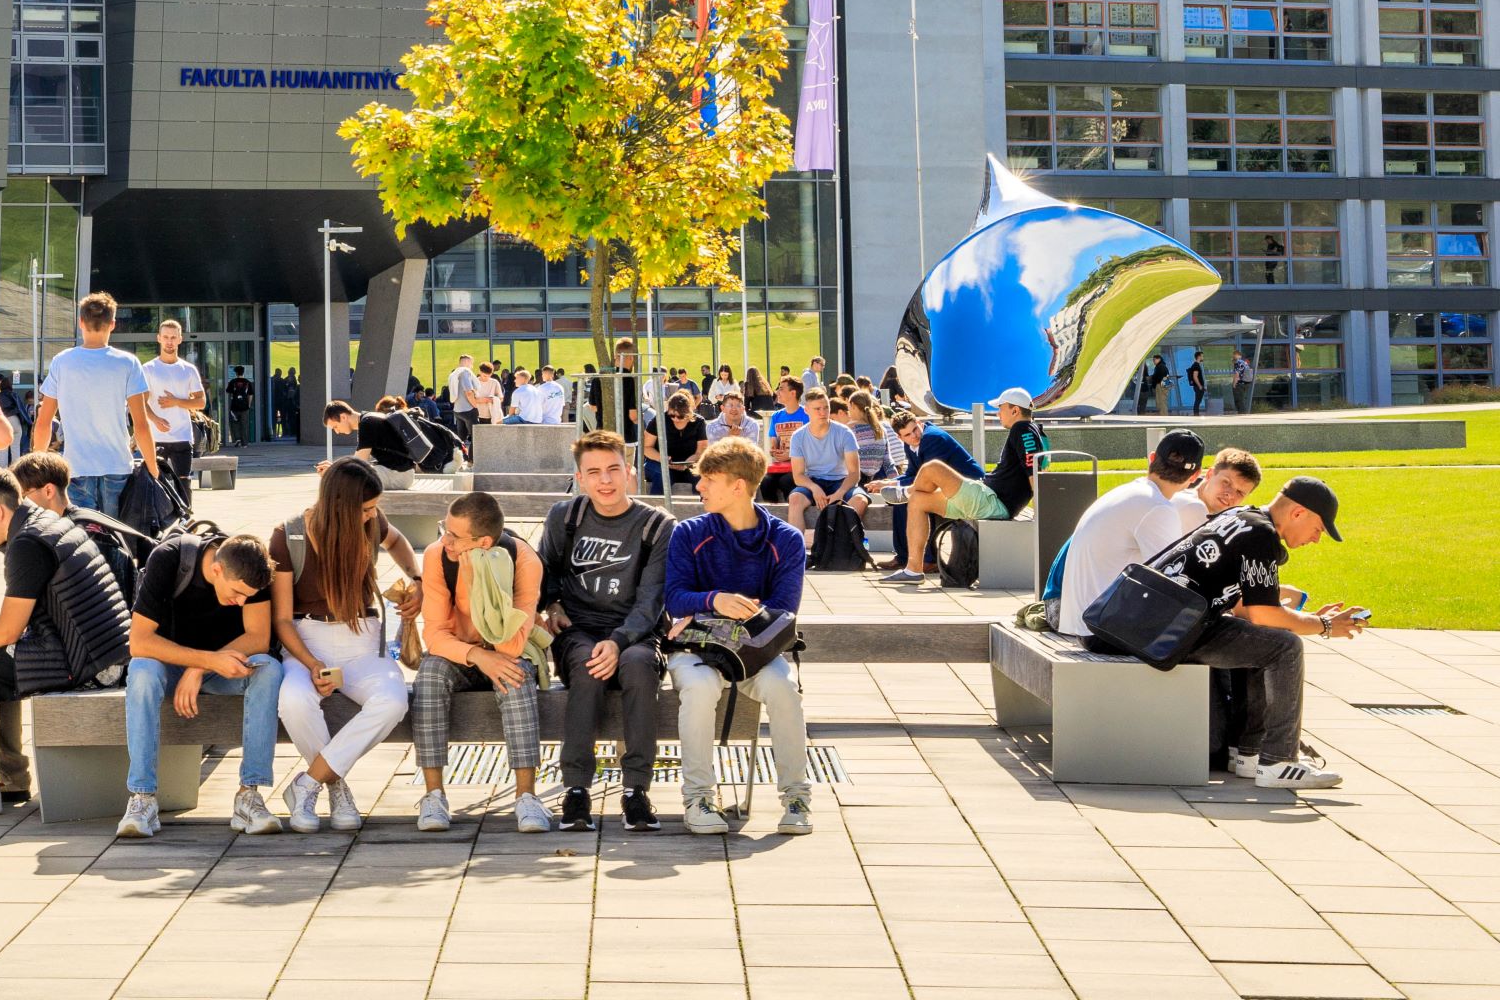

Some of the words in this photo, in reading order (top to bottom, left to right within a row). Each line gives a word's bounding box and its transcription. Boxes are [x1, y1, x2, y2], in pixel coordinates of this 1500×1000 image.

[180, 68, 266, 88] FAKULTA
[271, 68, 409, 91] HUMANITNÝC
[574, 536, 623, 561] NIKE
